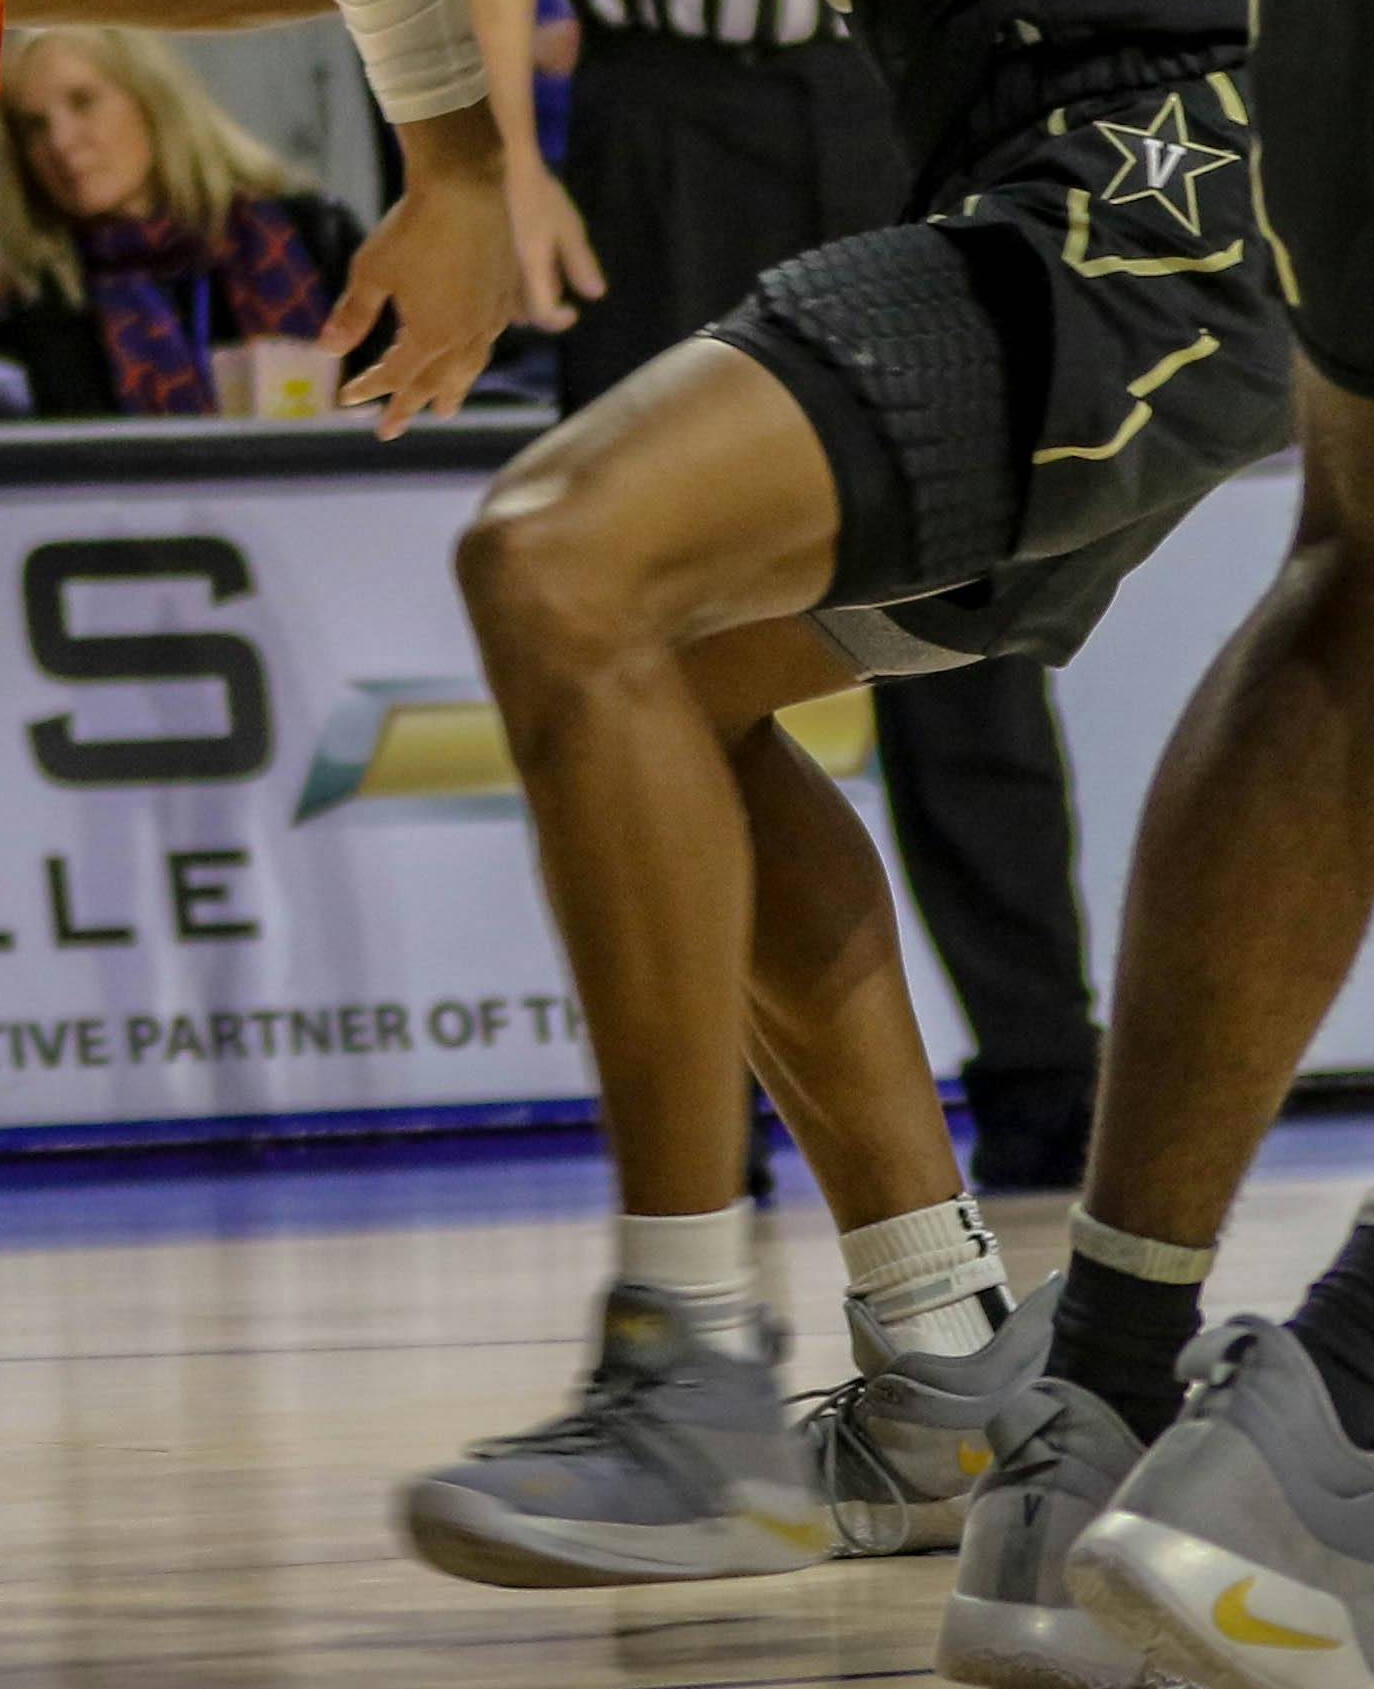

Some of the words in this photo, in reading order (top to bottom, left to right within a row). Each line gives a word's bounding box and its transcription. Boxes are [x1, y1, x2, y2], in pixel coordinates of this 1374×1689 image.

[1142, 138, 1188, 189] V
[128, 1001, 412, 1064] PARTNER
[428, 996, 508, 1052] OF
